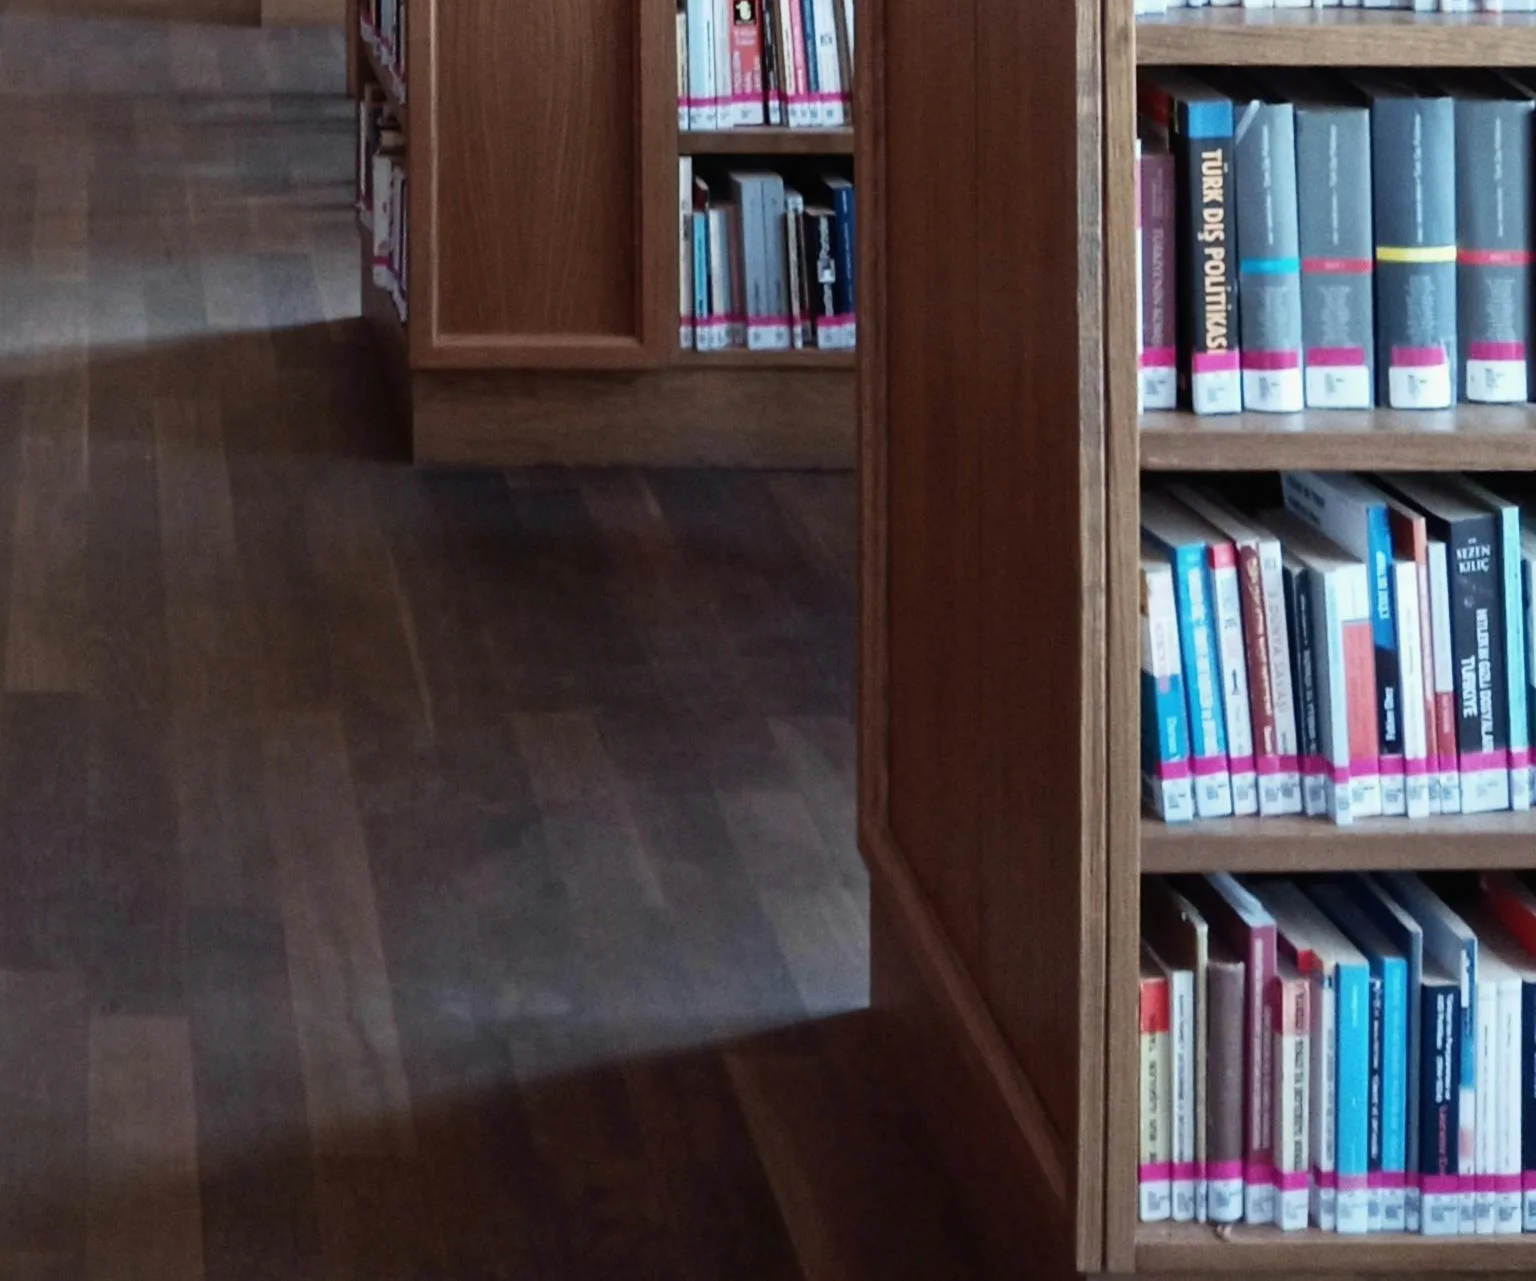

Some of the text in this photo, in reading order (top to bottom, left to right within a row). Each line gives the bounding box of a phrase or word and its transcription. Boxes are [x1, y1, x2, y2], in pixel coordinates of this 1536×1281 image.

[1197, 147, 1233, 355] TÜRK DIŞ POLİTİKASI
[1456, 544, 1491, 560] SEZEN
